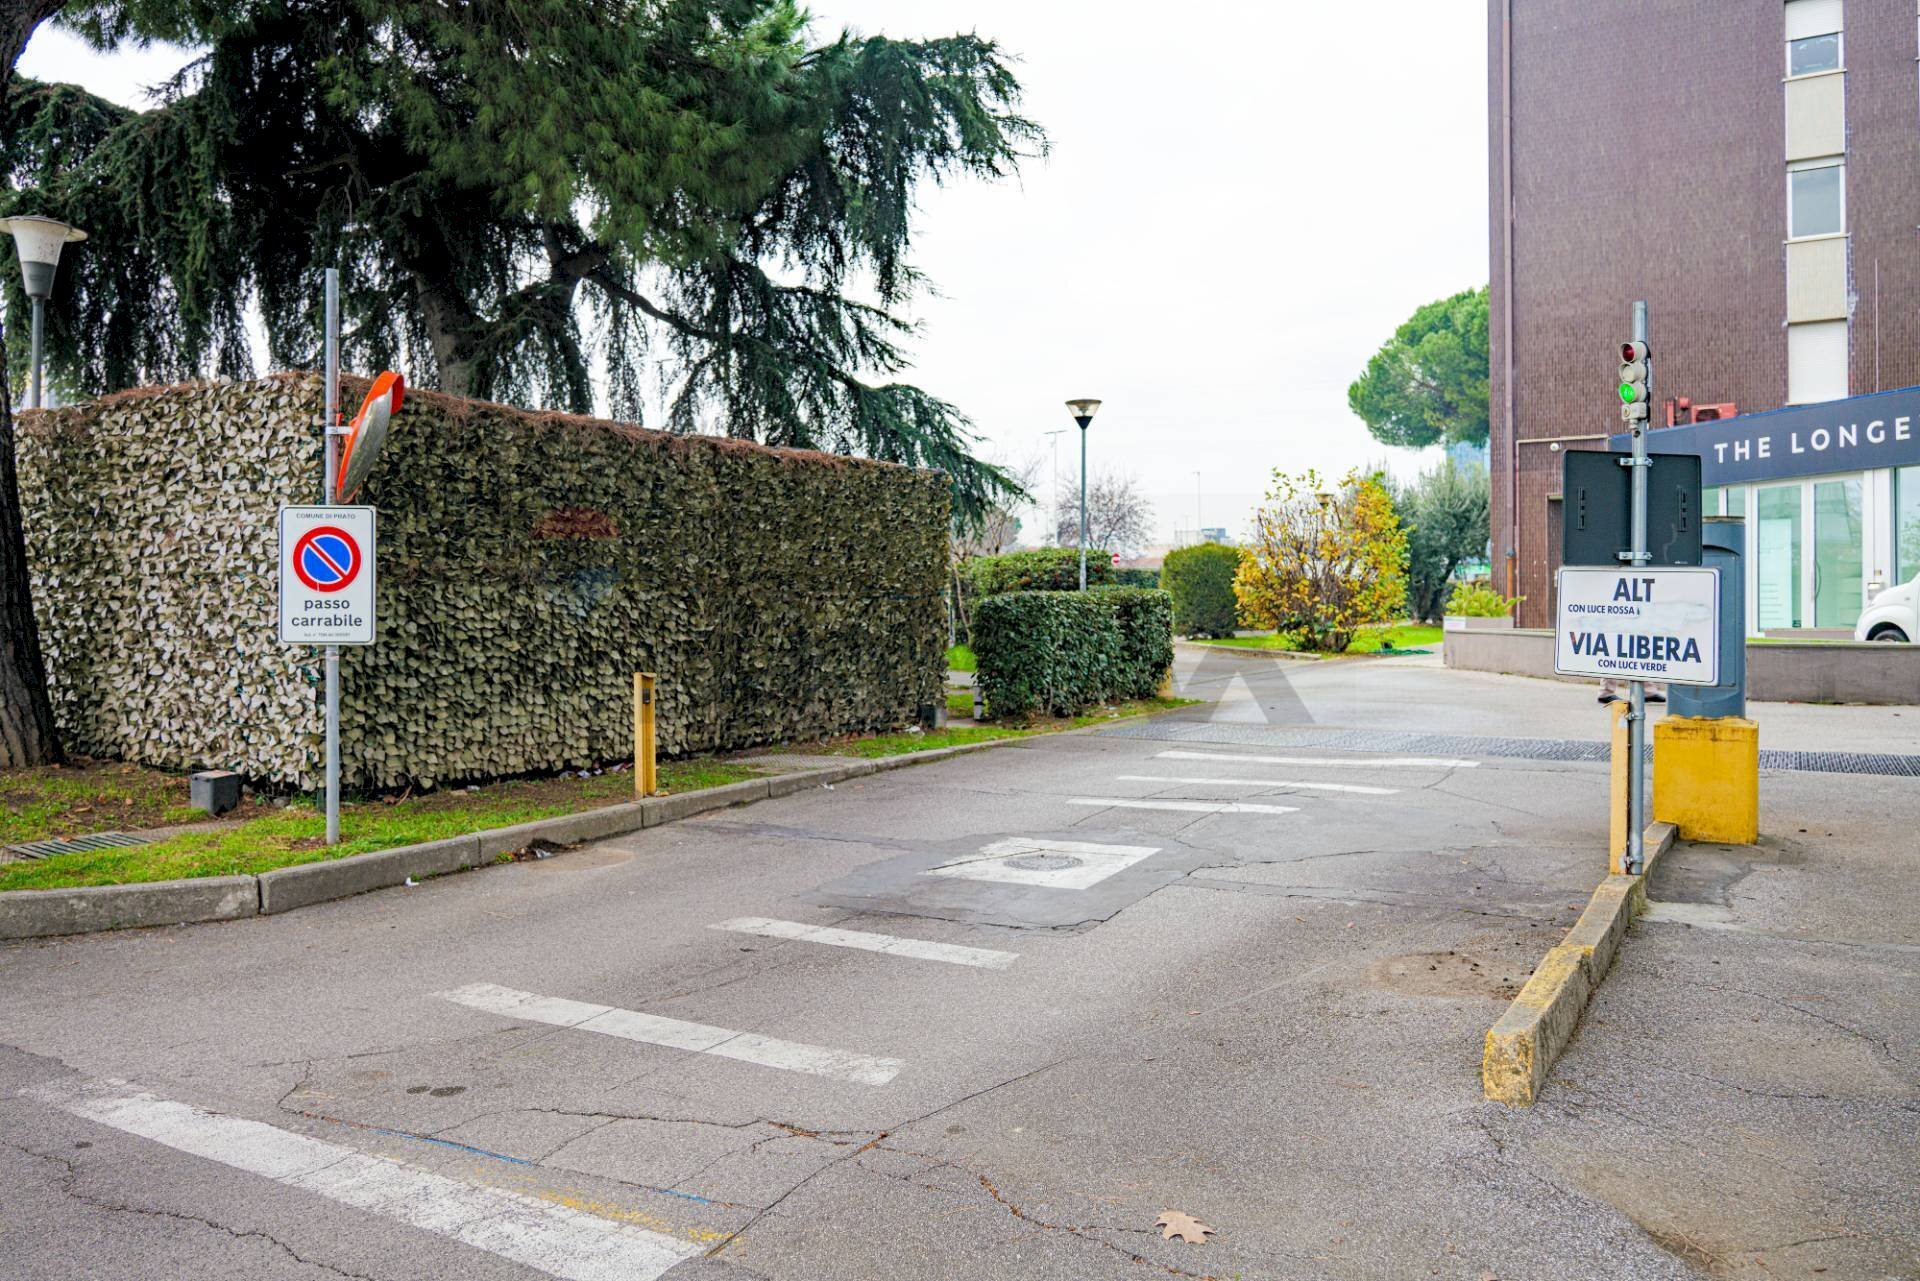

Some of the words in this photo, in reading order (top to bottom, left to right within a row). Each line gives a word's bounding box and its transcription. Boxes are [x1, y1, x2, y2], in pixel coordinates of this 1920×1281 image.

[1714, 436, 1771, 464] THE
[1791, 414, 1920, 454] LONGE
[296, 512, 324, 520] COMUNE
[1613, 578, 1655, 602] ALT
[304, 599, 350, 611] passo
[1568, 604, 1585, 613] CON
[1587, 604, 1605, 614] LUCE
[1608, 605, 1634, 615] ROSSA
[291, 614, 362, 627] carrabile
[1569, 631, 1609, 657] VIA
[1617, 634, 1701, 663] LIBERA
[1598, 659, 1616, 668] CON
[1618, 660, 1638, 670] LUCE
[1640, 662, 1667, 672] VERDE
